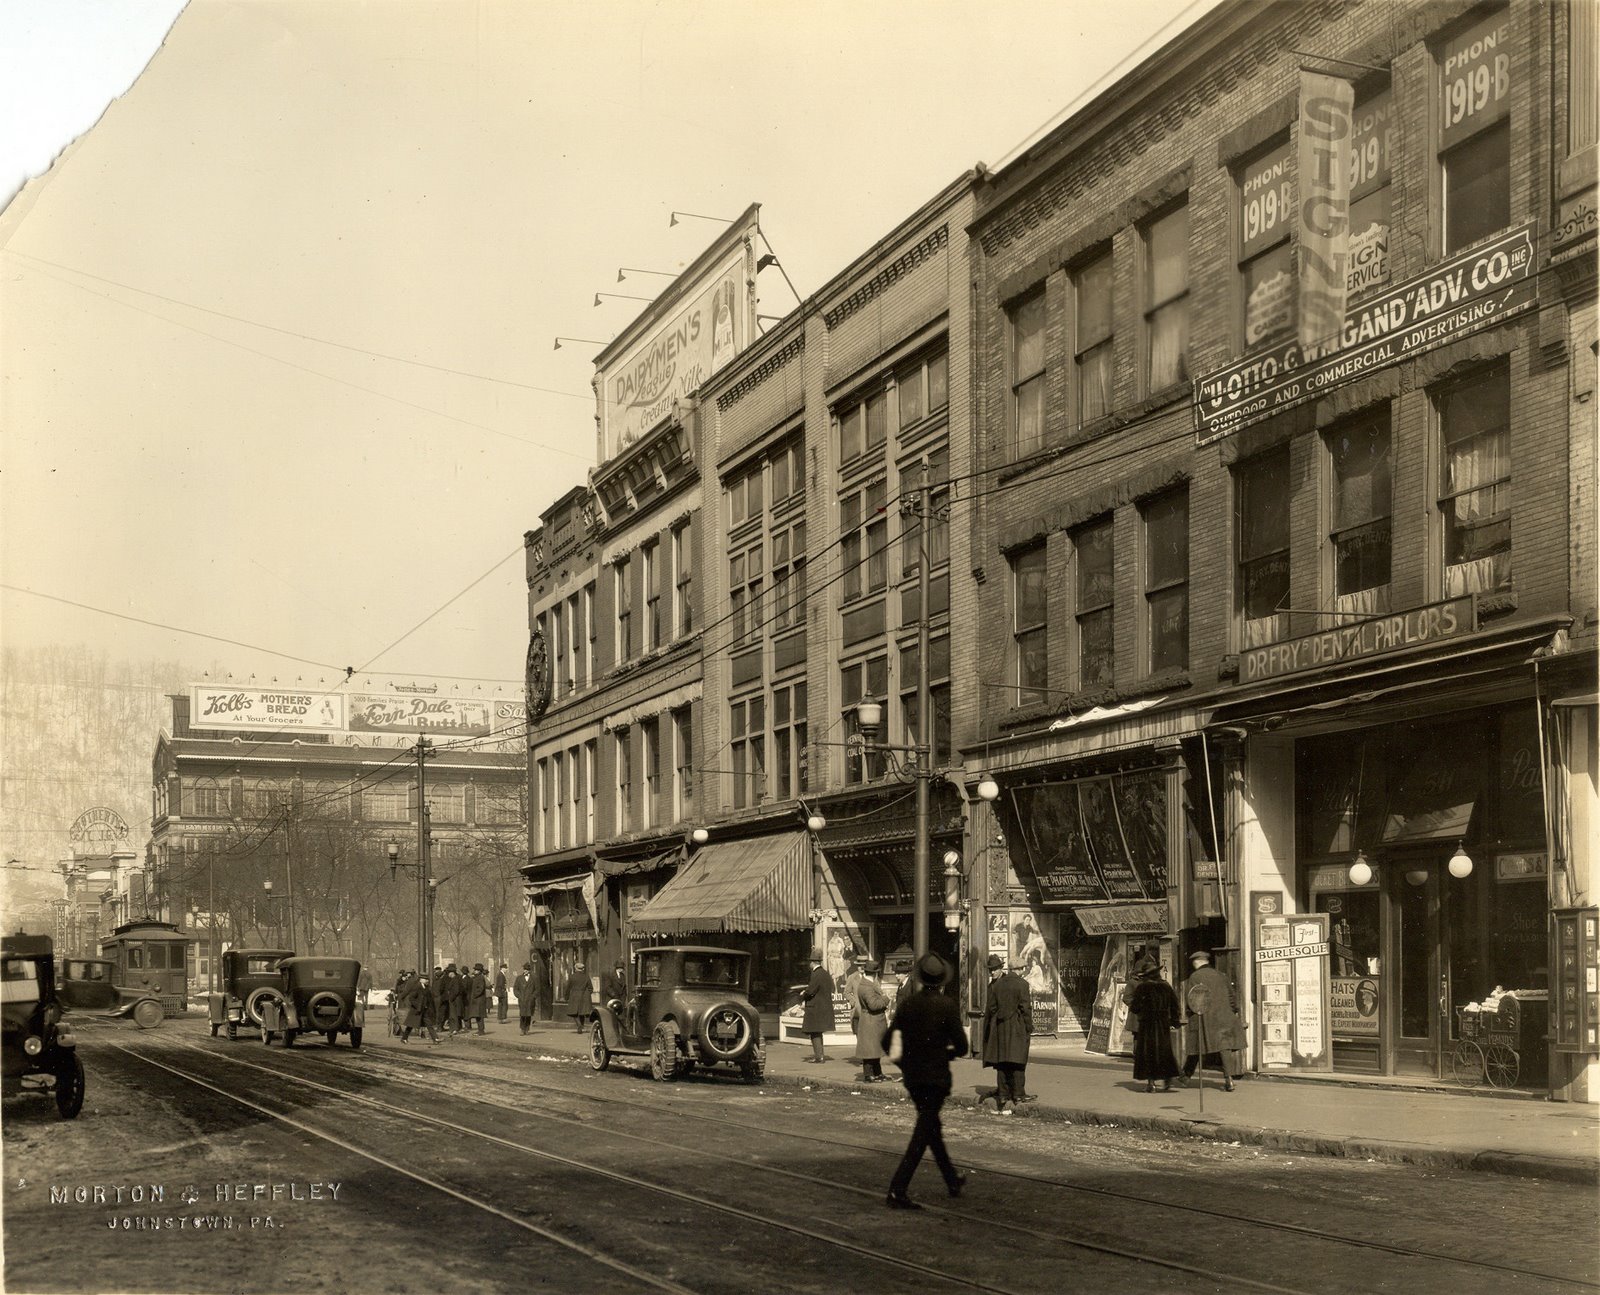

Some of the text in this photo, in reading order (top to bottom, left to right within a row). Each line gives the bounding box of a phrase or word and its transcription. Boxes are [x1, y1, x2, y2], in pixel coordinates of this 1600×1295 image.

[1445, 23, 1510, 76] PHONE
[1243, 155, 1292, 197] PHONE
[1348, 236, 1388, 270] IGN
[1346, 257, 1387, 292] ERVICE
[1471, 251, 1513, 292] CO.
[616, 310, 702, 406] DAIRYMEN'S
[1274, 384, 1301, 406] AND
[1305, 343, 1395, 392] COMMERCIAL
[1313, 623, 1372, 665] DENTAL
[1375, 605, 1458, 650] PARLORS
[202, 692, 254, 716] Kolb's
[260, 694, 312, 706] MOTHER'S
[266, 704, 307, 715] BREAD
[365, 698, 455, 725] Fern Dale
[232, 714, 304, 724] At Your Grocers
[1258, 943, 1327, 960] BURLESQUE
[1330, 997, 1355, 1008] CLEANED
[1331, 981, 1355, 995] HATS
